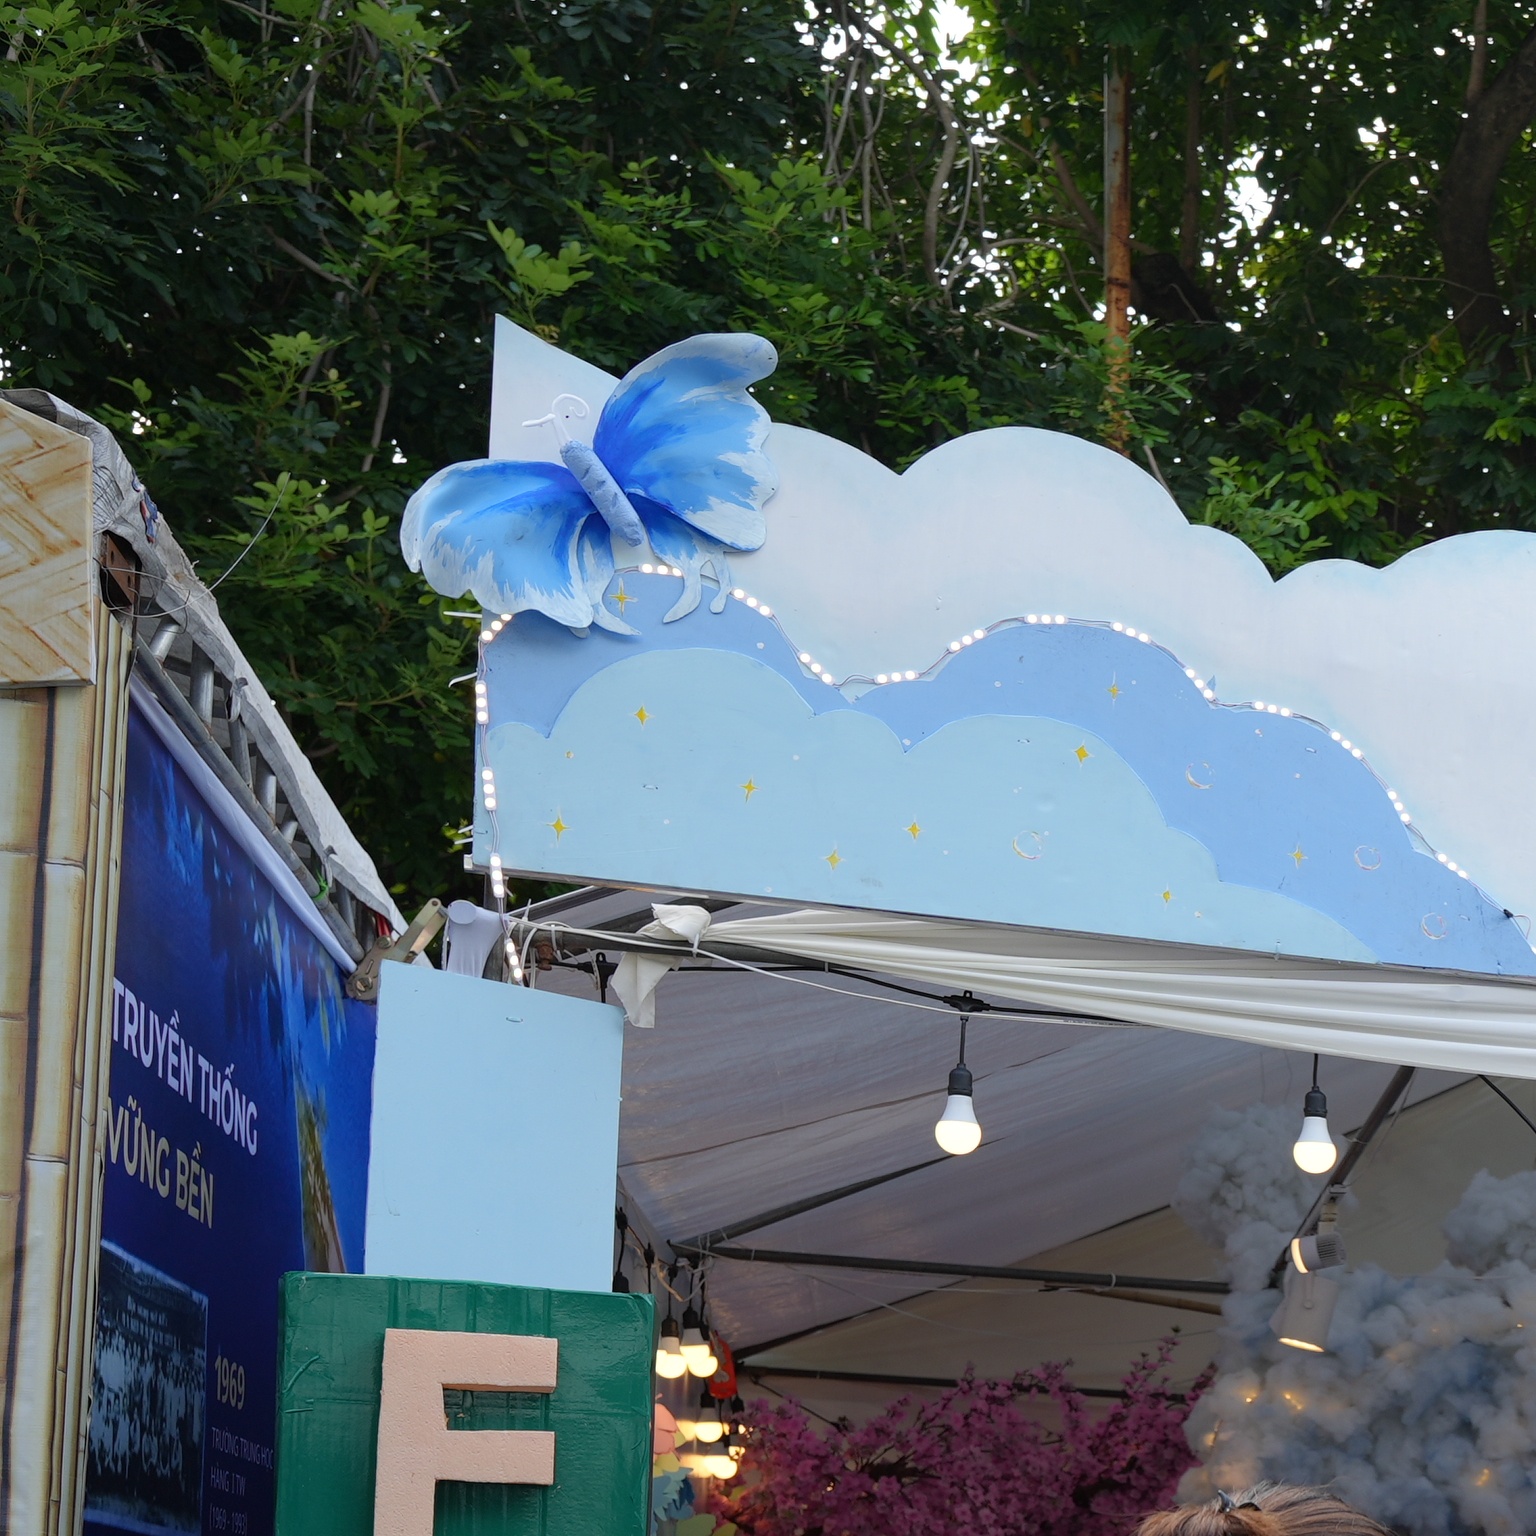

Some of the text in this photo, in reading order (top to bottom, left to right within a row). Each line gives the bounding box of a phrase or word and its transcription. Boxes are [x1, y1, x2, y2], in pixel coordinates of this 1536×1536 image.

[112, 976, 258, 1156] TRUYỀN THỐNG
[107, 1094, 214, 1230] VỮNG BỀN
[214, 1354, 246, 1411] 1969
